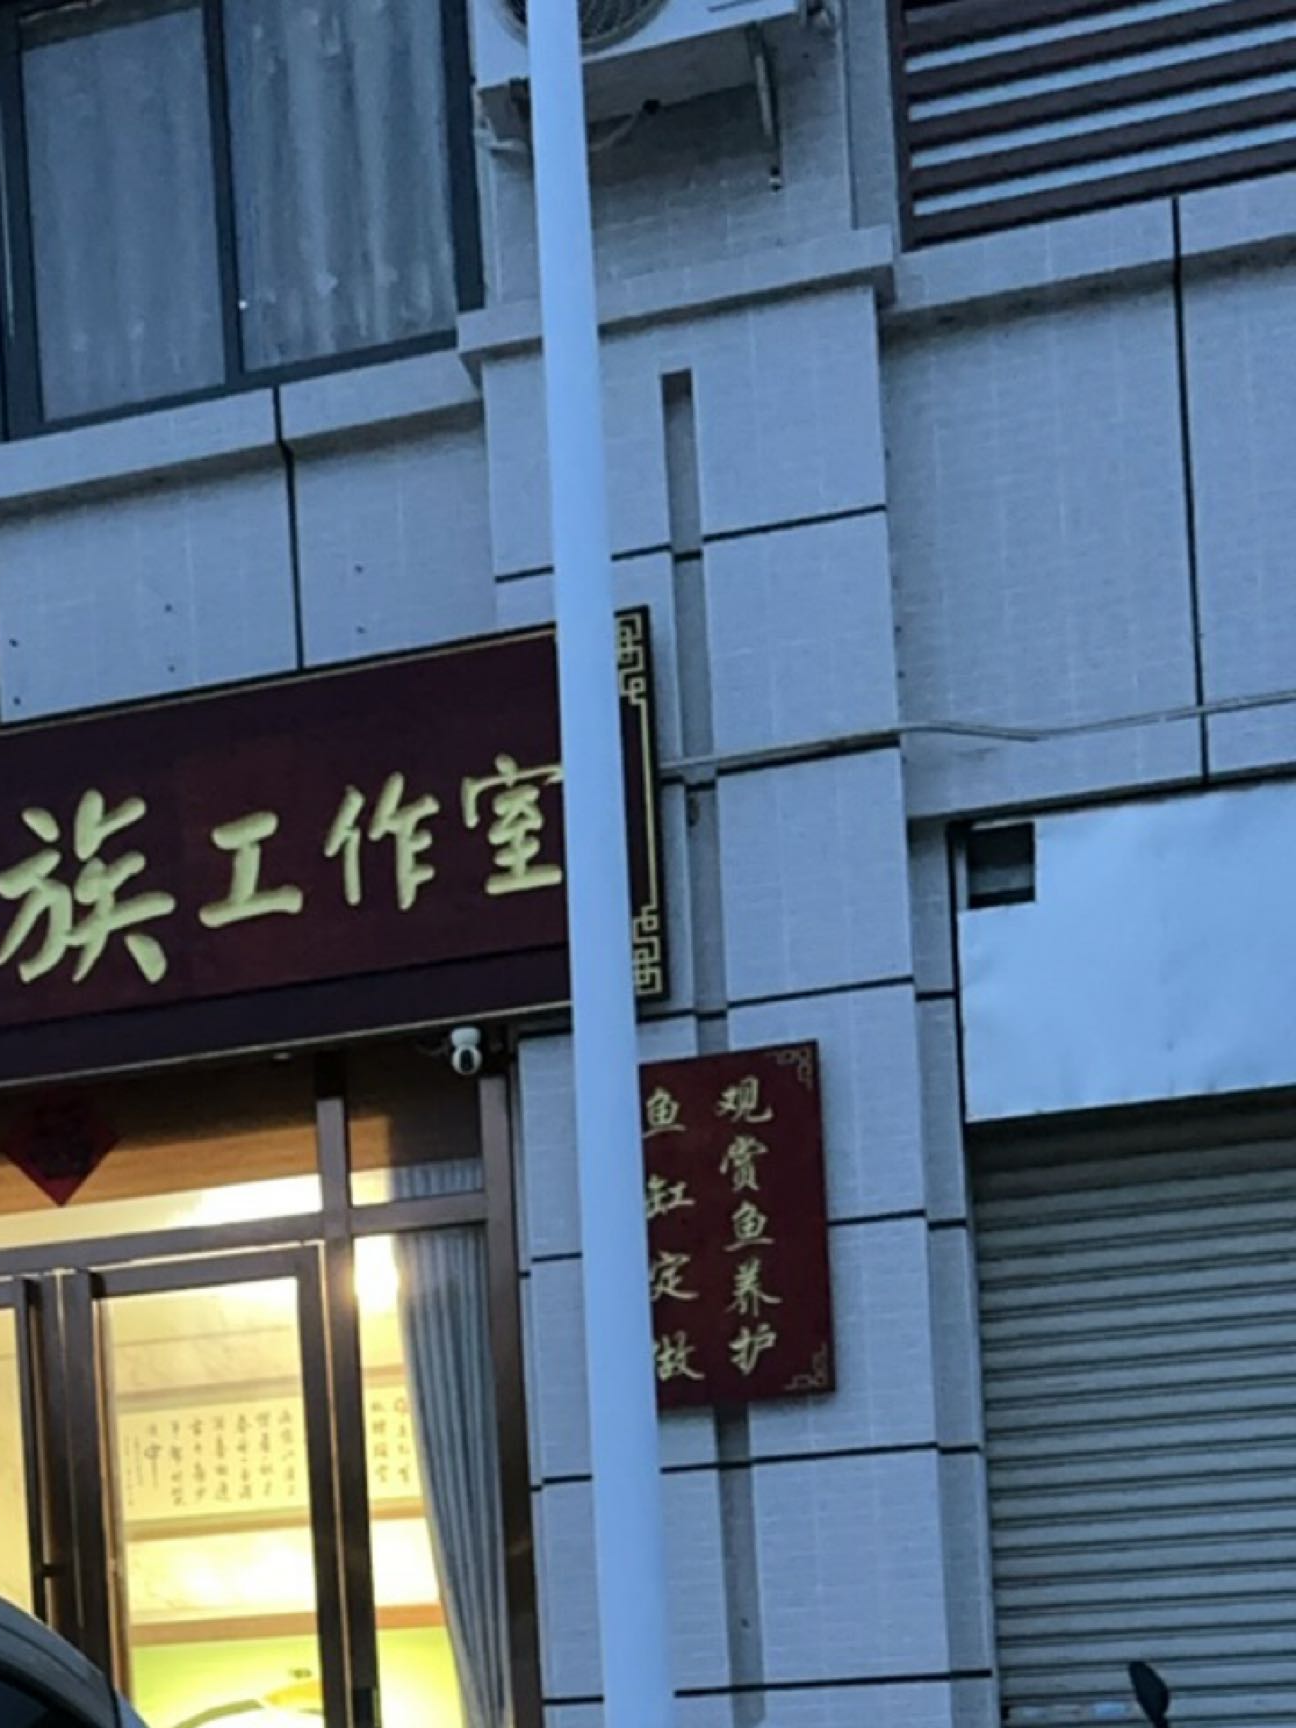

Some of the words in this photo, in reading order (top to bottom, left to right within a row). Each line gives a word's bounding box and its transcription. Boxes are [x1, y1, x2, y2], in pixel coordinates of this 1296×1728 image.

[714, 1075, 783, 1376] 观赏鱼养护
